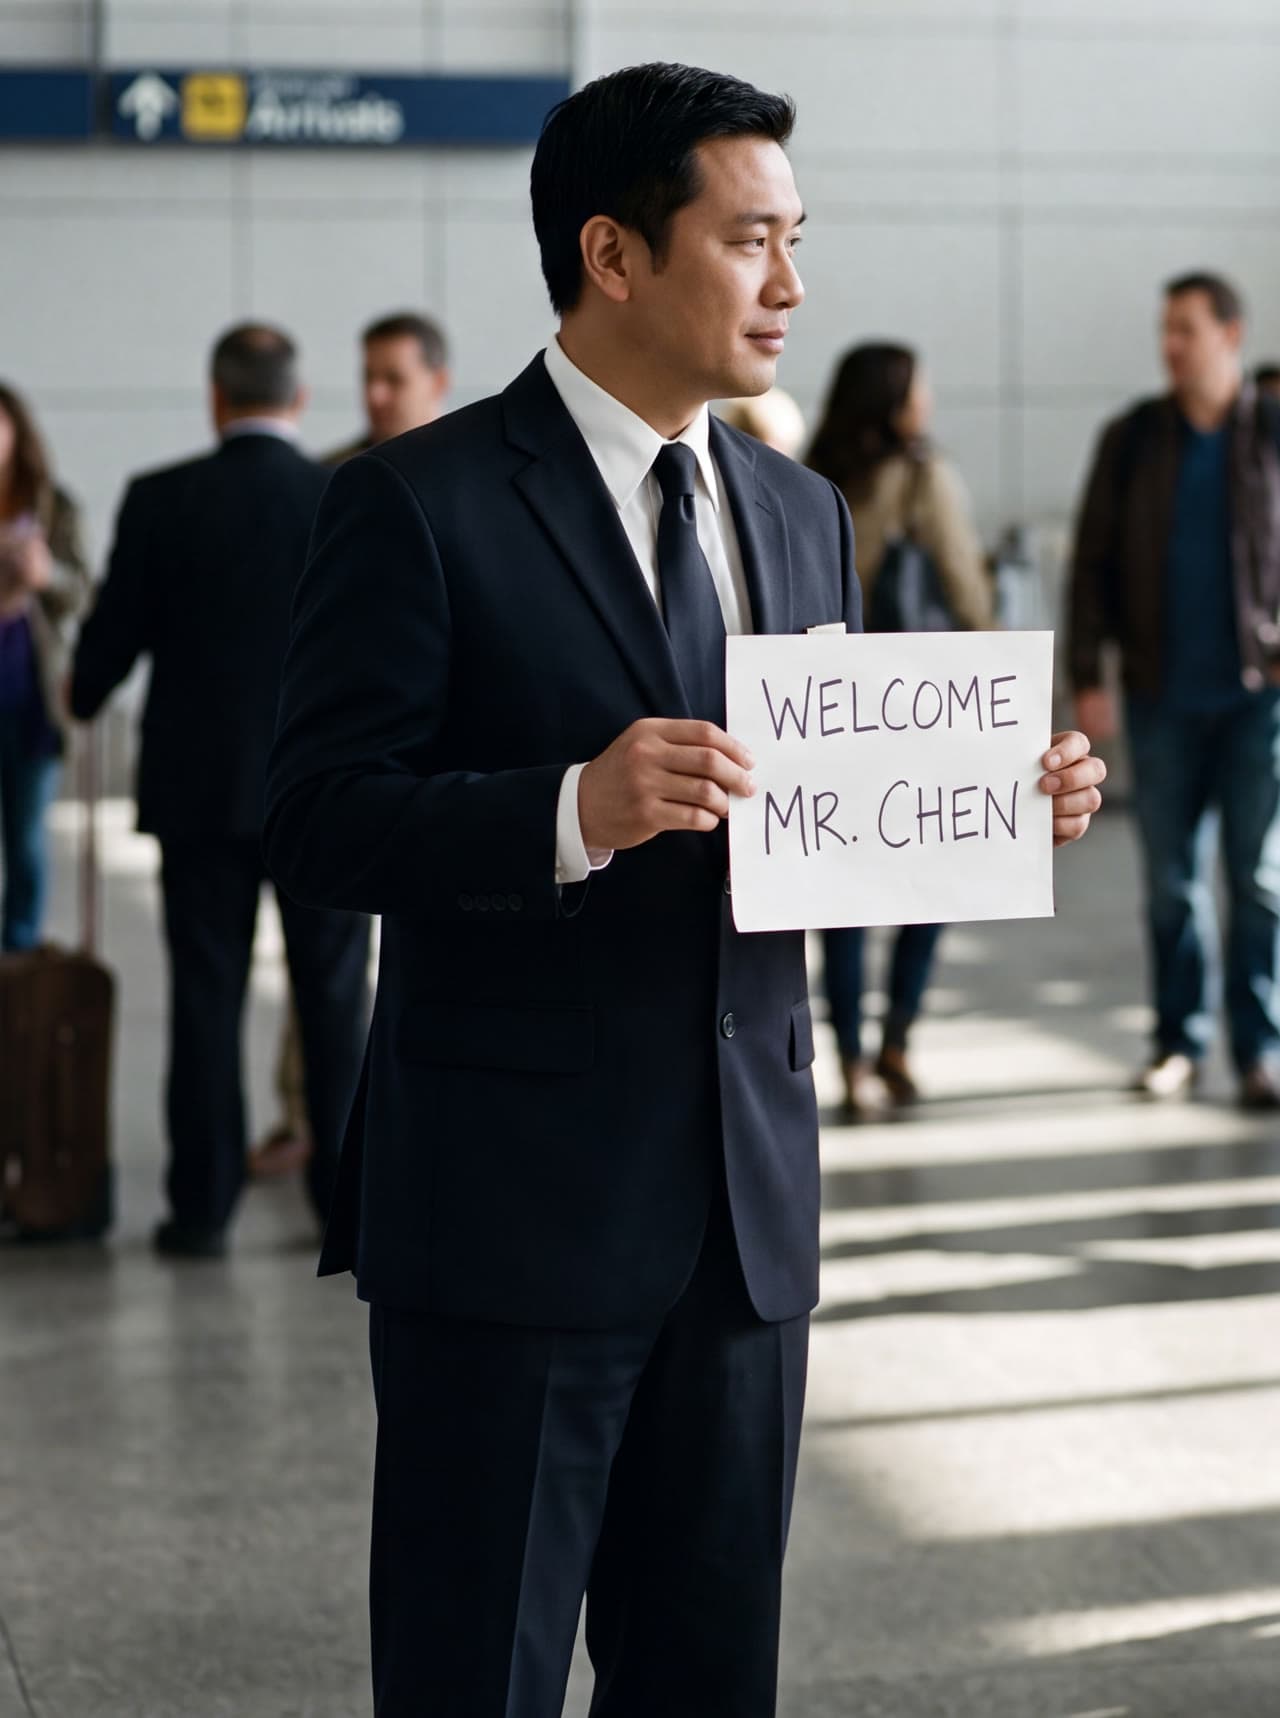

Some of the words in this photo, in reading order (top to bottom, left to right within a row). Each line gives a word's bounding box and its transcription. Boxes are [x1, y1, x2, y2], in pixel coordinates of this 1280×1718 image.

[762, 675, 1019, 740] WELCOME
[764, 784, 858, 857] MR.
[878, 780, 1019, 848] CHEN
